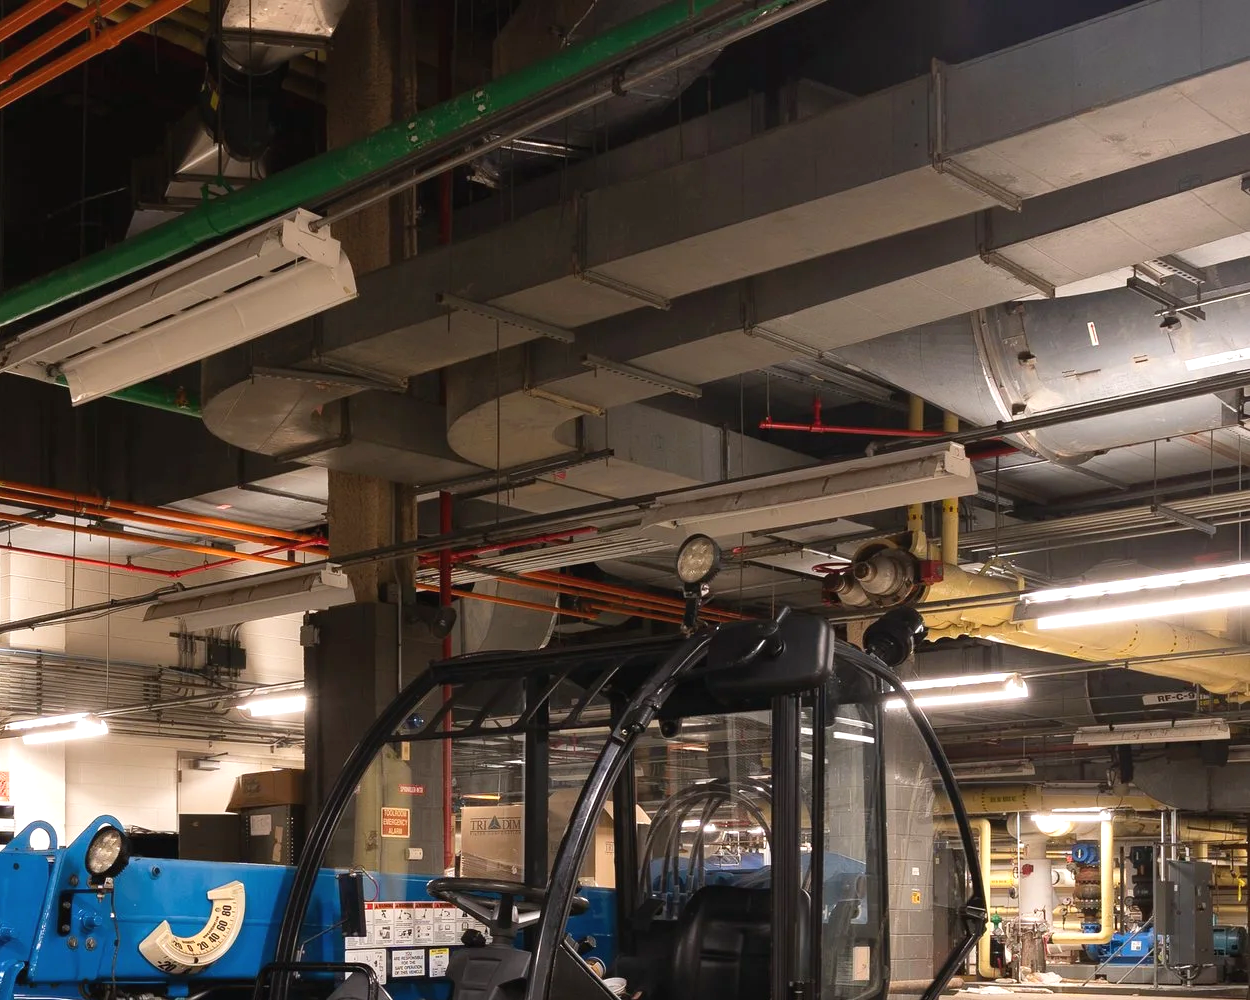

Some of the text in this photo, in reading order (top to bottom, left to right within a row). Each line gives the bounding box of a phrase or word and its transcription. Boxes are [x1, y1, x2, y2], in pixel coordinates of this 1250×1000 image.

[1158, 692, 1195, 702] RF-C-9
[383, 818, 408, 826] EMERGENCY
[470, 819, 521, 830] TRI DIM
[388, 827, 403, 835] ALARM
[222, 905, 232, 917] 80
[217, 920, 228, 932] 60
[209, 932, 220, 943] 40
[197, 941, 209, 951] 20
